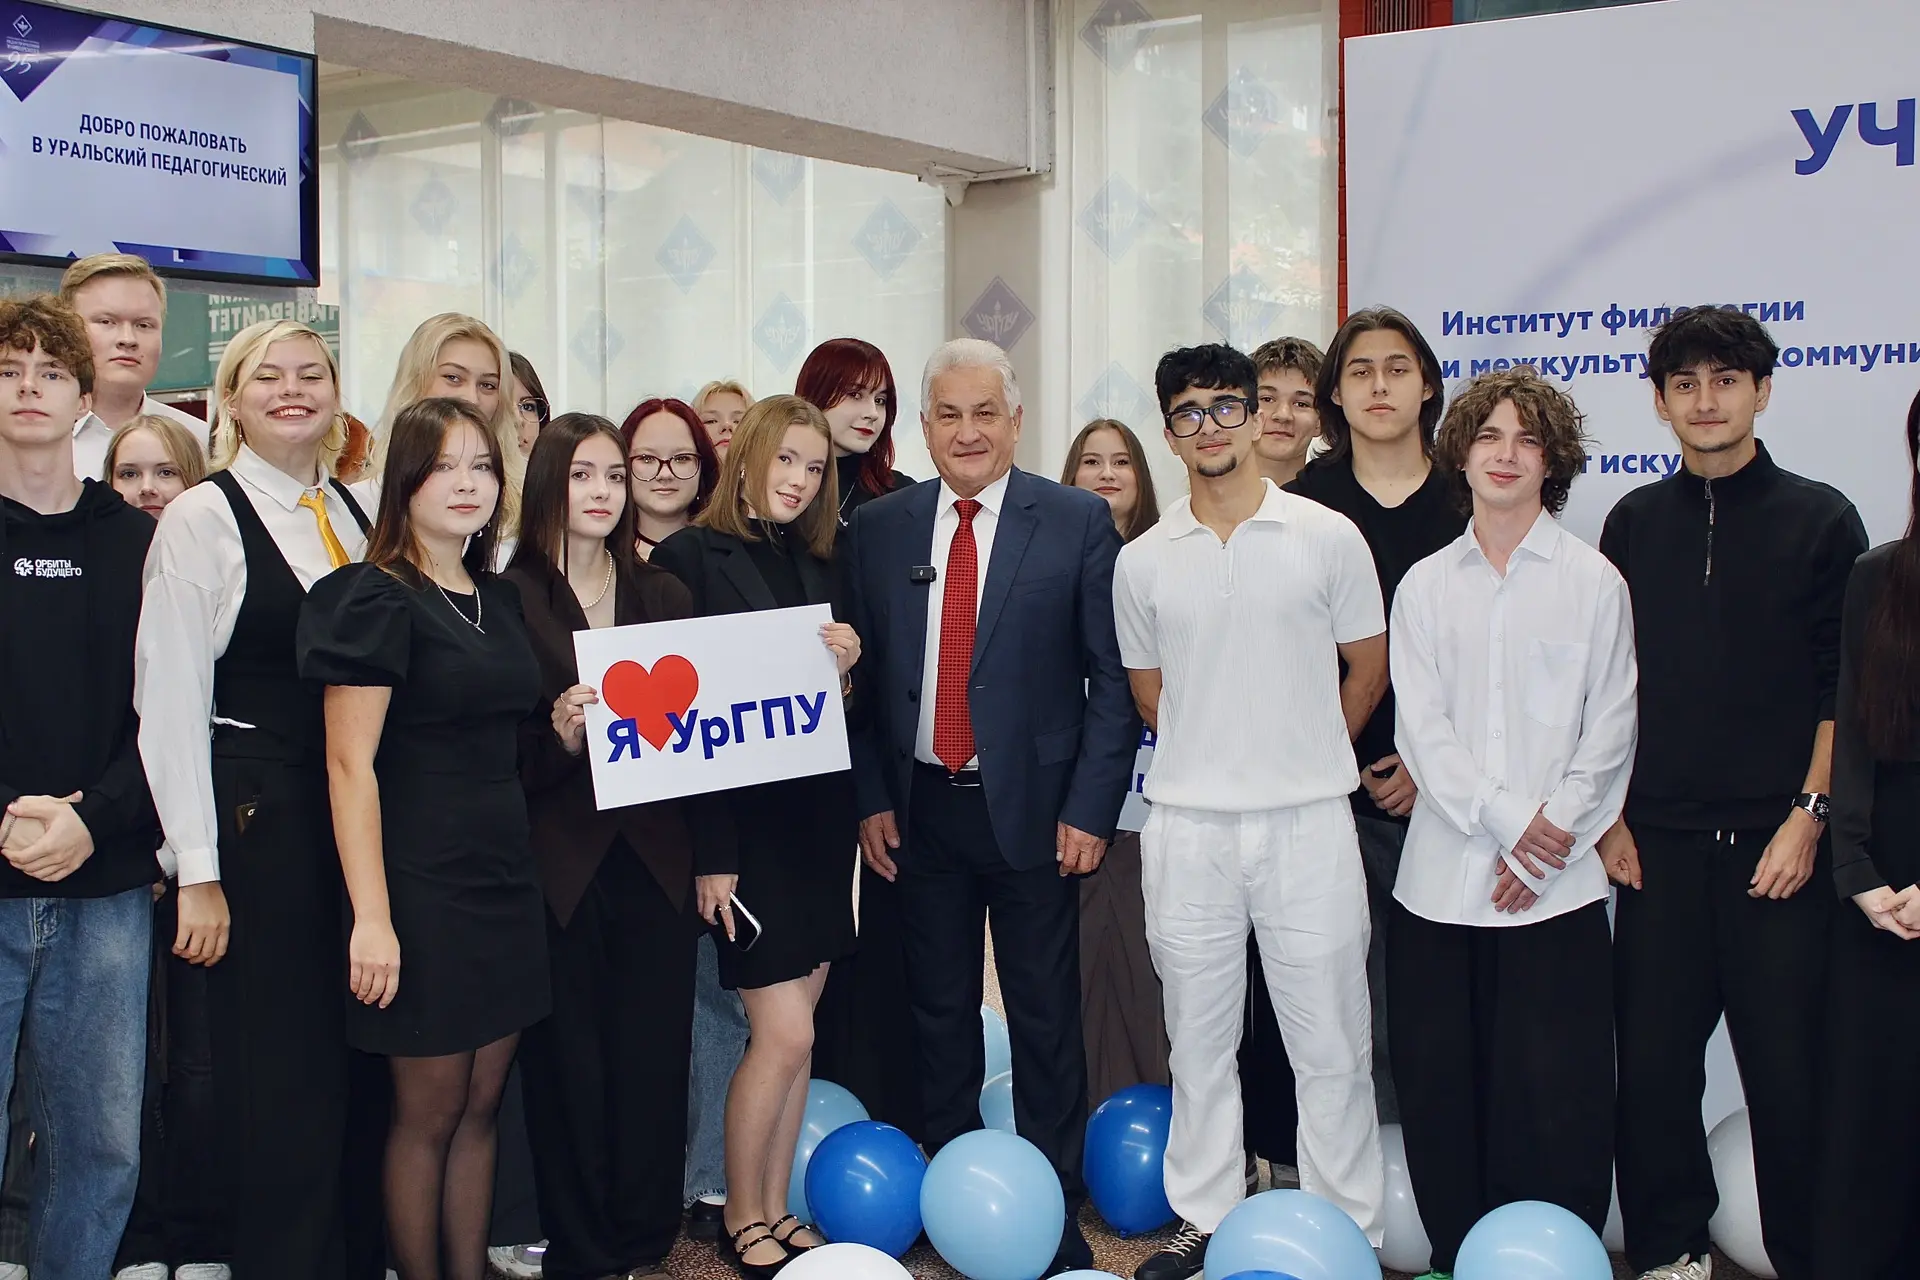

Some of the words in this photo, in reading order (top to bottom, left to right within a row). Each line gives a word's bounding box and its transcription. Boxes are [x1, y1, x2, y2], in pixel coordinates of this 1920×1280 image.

[80, 114, 135, 138] ДОБРО
[140, 122, 247, 154] ПОЖАЛОВАТЬ
[32, 136, 43, 153] В
[48, 137, 147, 167] УРАЛЬСКИЙ
[151, 153, 287, 186] ПЕДАГОГИЧЕСКИЙ
[1442, 309, 1594, 338] Институт
[1442, 360, 1460, 379] и
[1774, 343, 1920, 373] оммуни
[1600, 453, 1682, 480] иску
[35, 559, 72, 568] ОРБИТЫ
[35, 567, 82, 578] БУДУЩЕГО
[606, 717, 642, 763] Я
[665, 690, 828, 760] УрГПУ
